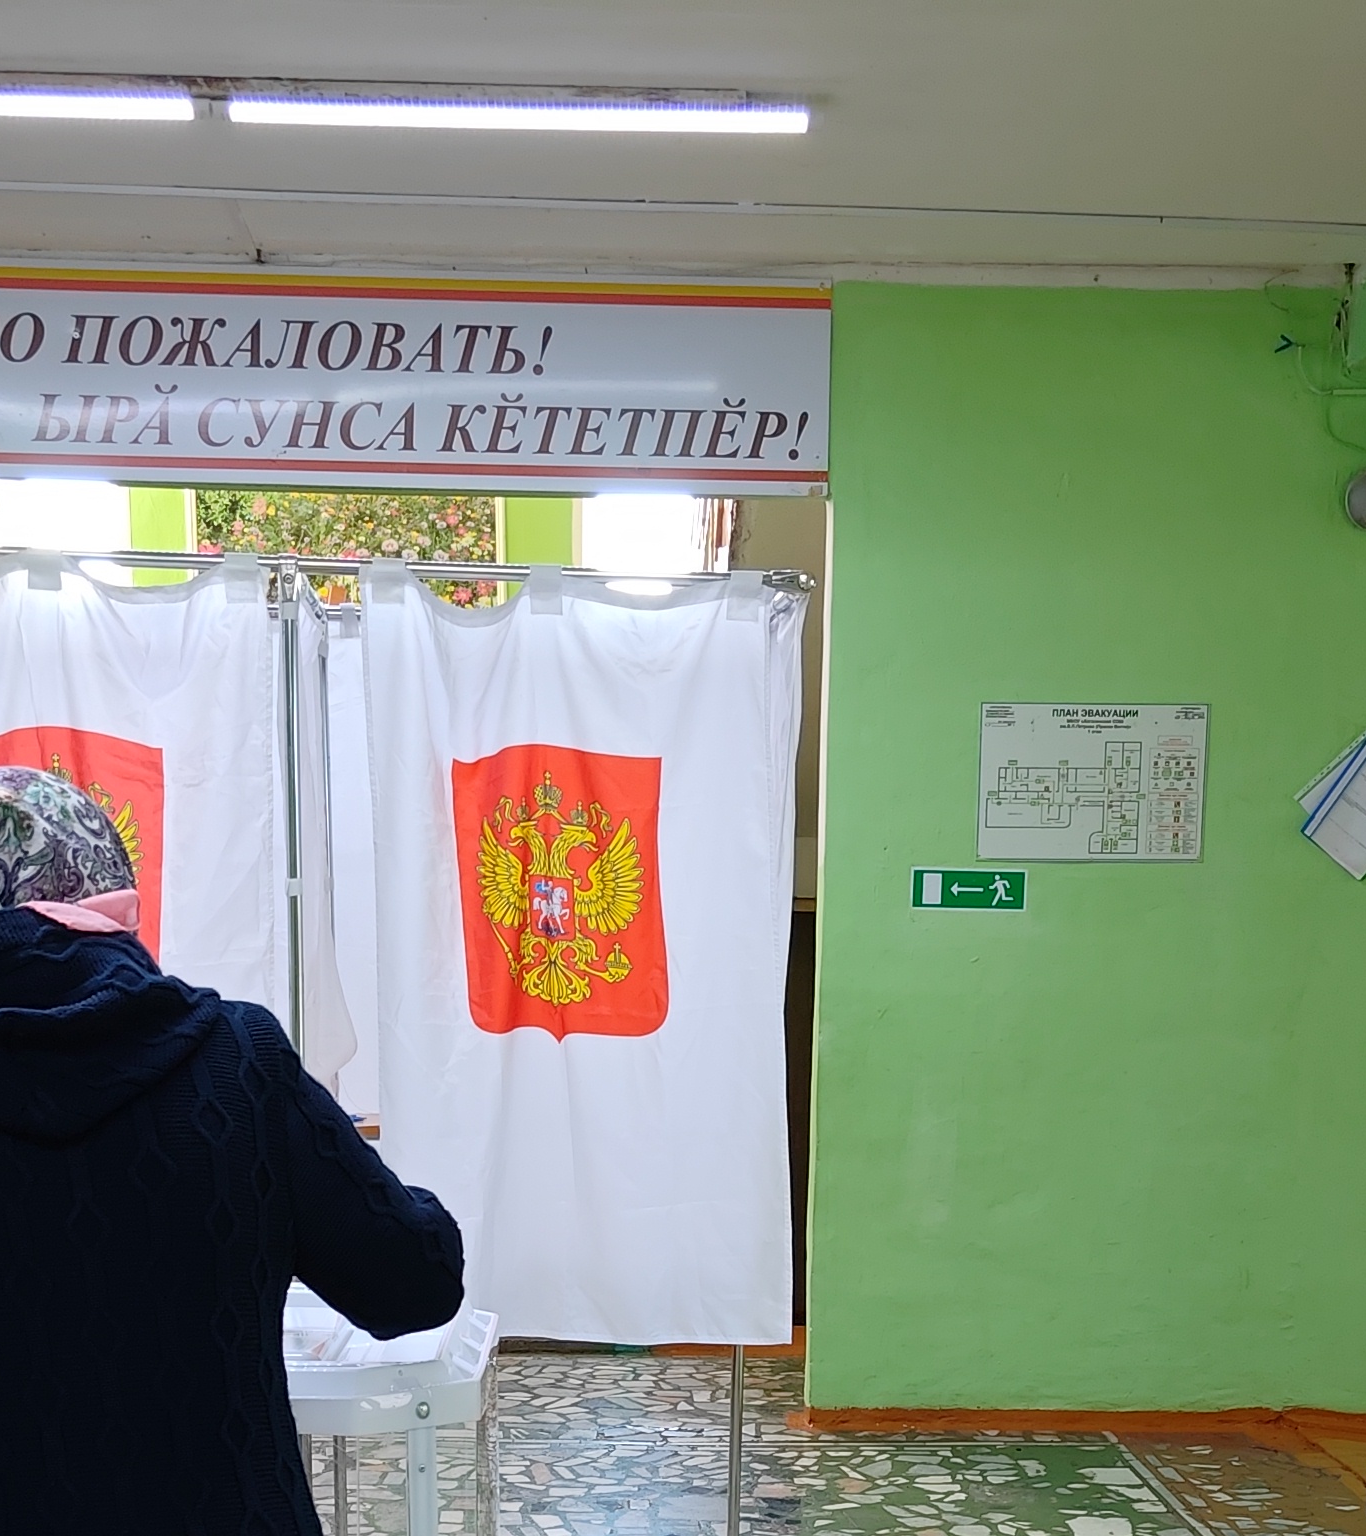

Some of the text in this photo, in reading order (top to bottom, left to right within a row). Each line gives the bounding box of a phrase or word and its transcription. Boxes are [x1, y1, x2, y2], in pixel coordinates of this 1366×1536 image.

[60, 313, 554, 377] ПОЖАЛОВАТЬ!
[30, 383, 179, 446] ЫРӐ
[196, 397, 418, 452] СУНСА
[1052, 708, 1139, 719] ПЛАН ЭВАКУАЦИИ
